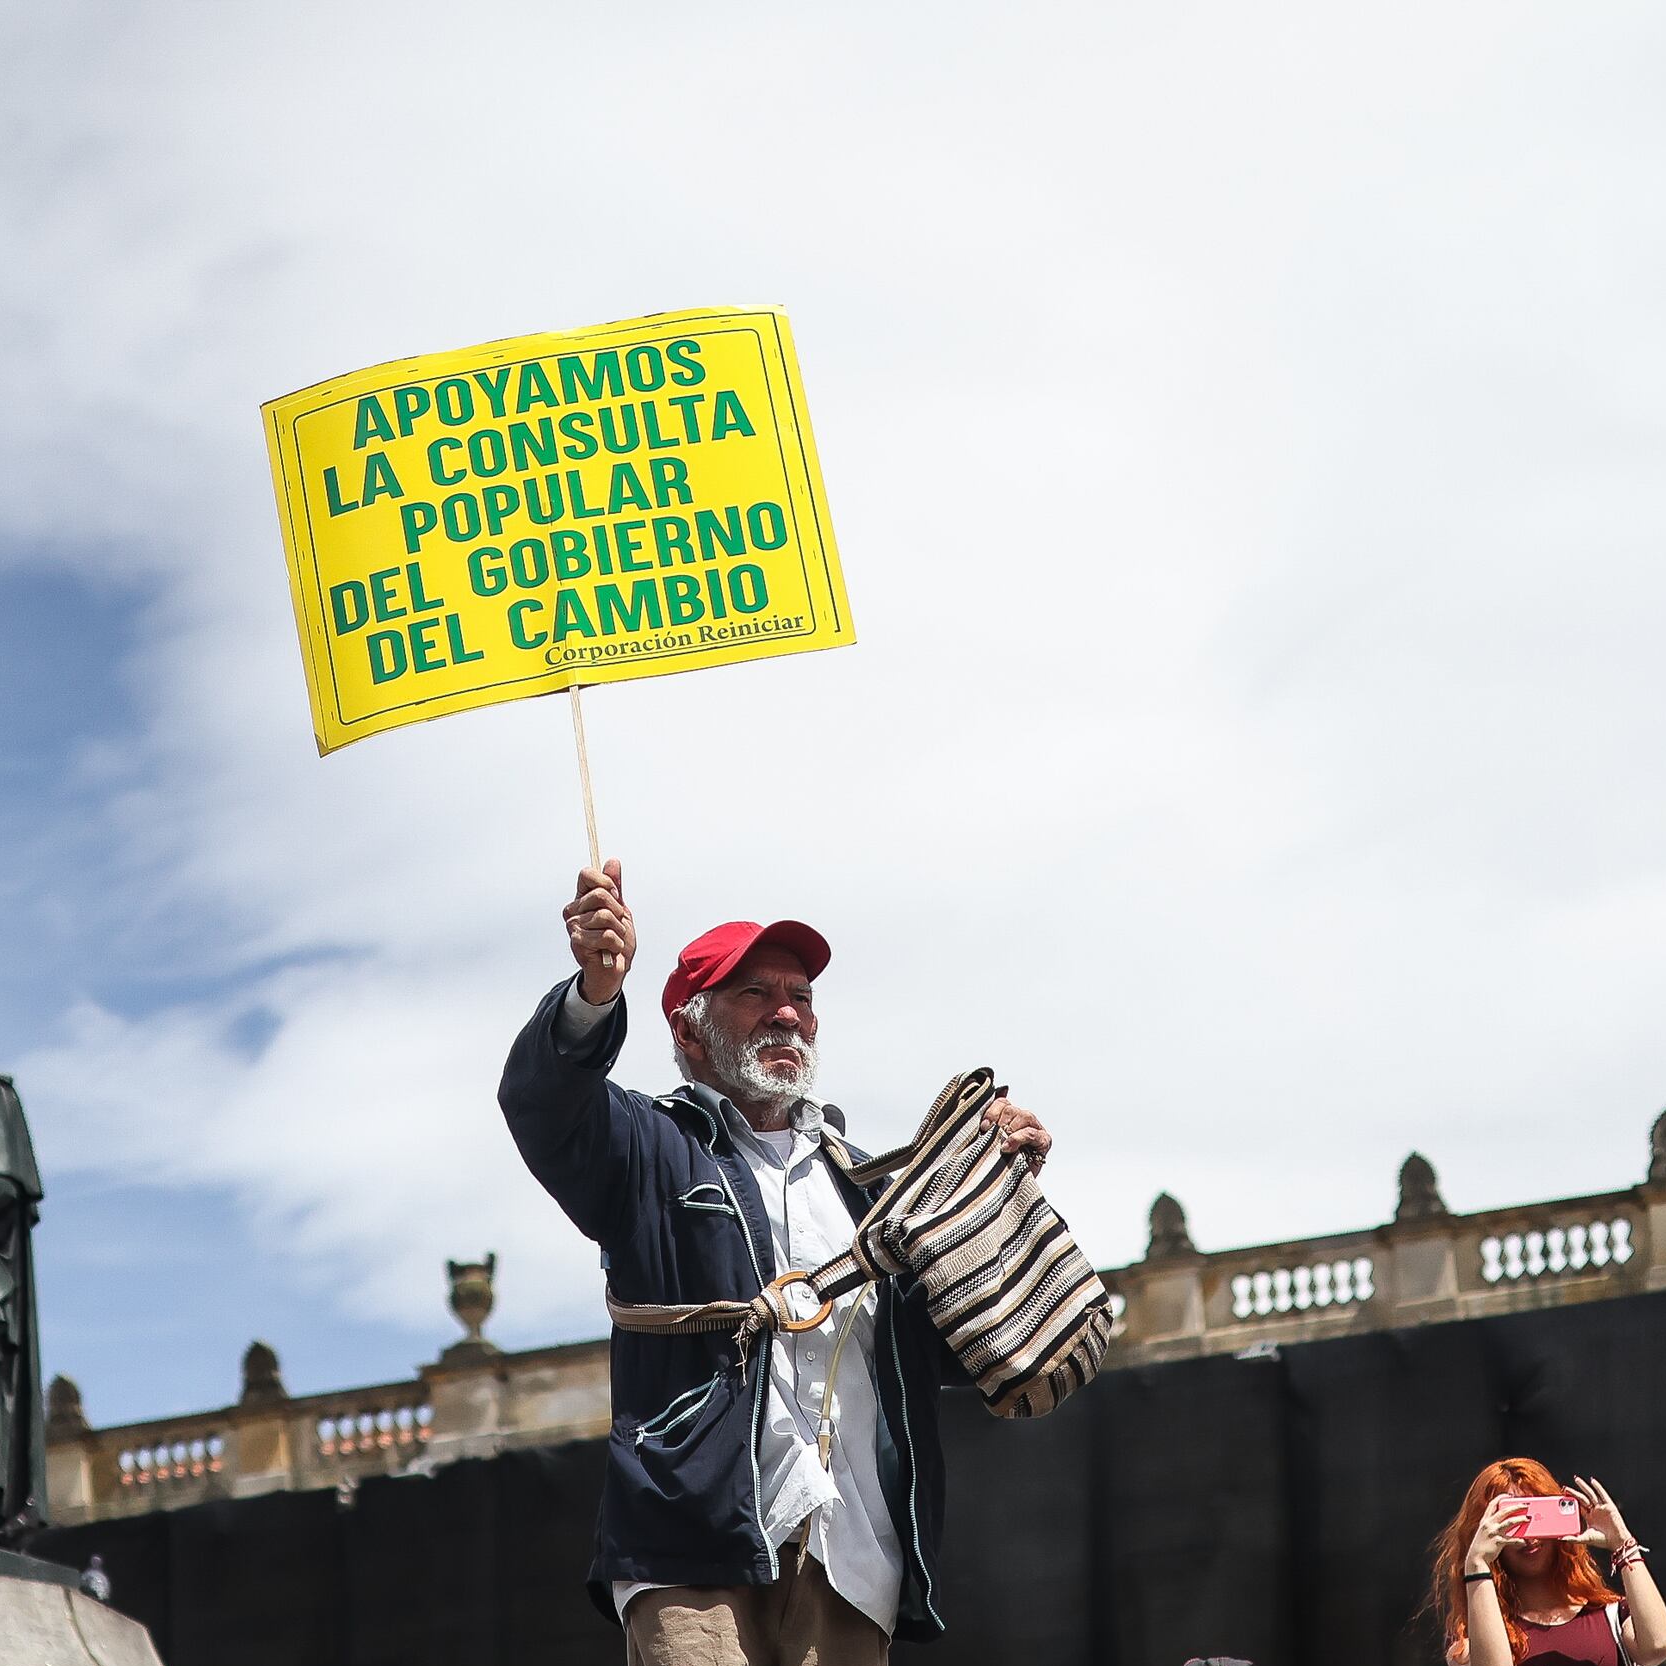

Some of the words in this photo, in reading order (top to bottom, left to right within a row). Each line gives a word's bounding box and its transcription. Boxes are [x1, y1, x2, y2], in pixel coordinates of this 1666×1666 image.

[353, 338, 707, 451] APOYAMOS
[323, 451, 405, 518] LA
[427, 390, 757, 487] CONSULTA
[399, 456, 694, 555] POPULAR
[329, 561, 445, 637] DEL
[467, 501, 789, 597] GOBIERNO
[365, 612, 485, 686] DEL
[507, 563, 770, 651] CAMBIO
[544, 632, 693, 668] Corporación
[699, 612, 805, 645] Reiniciar
